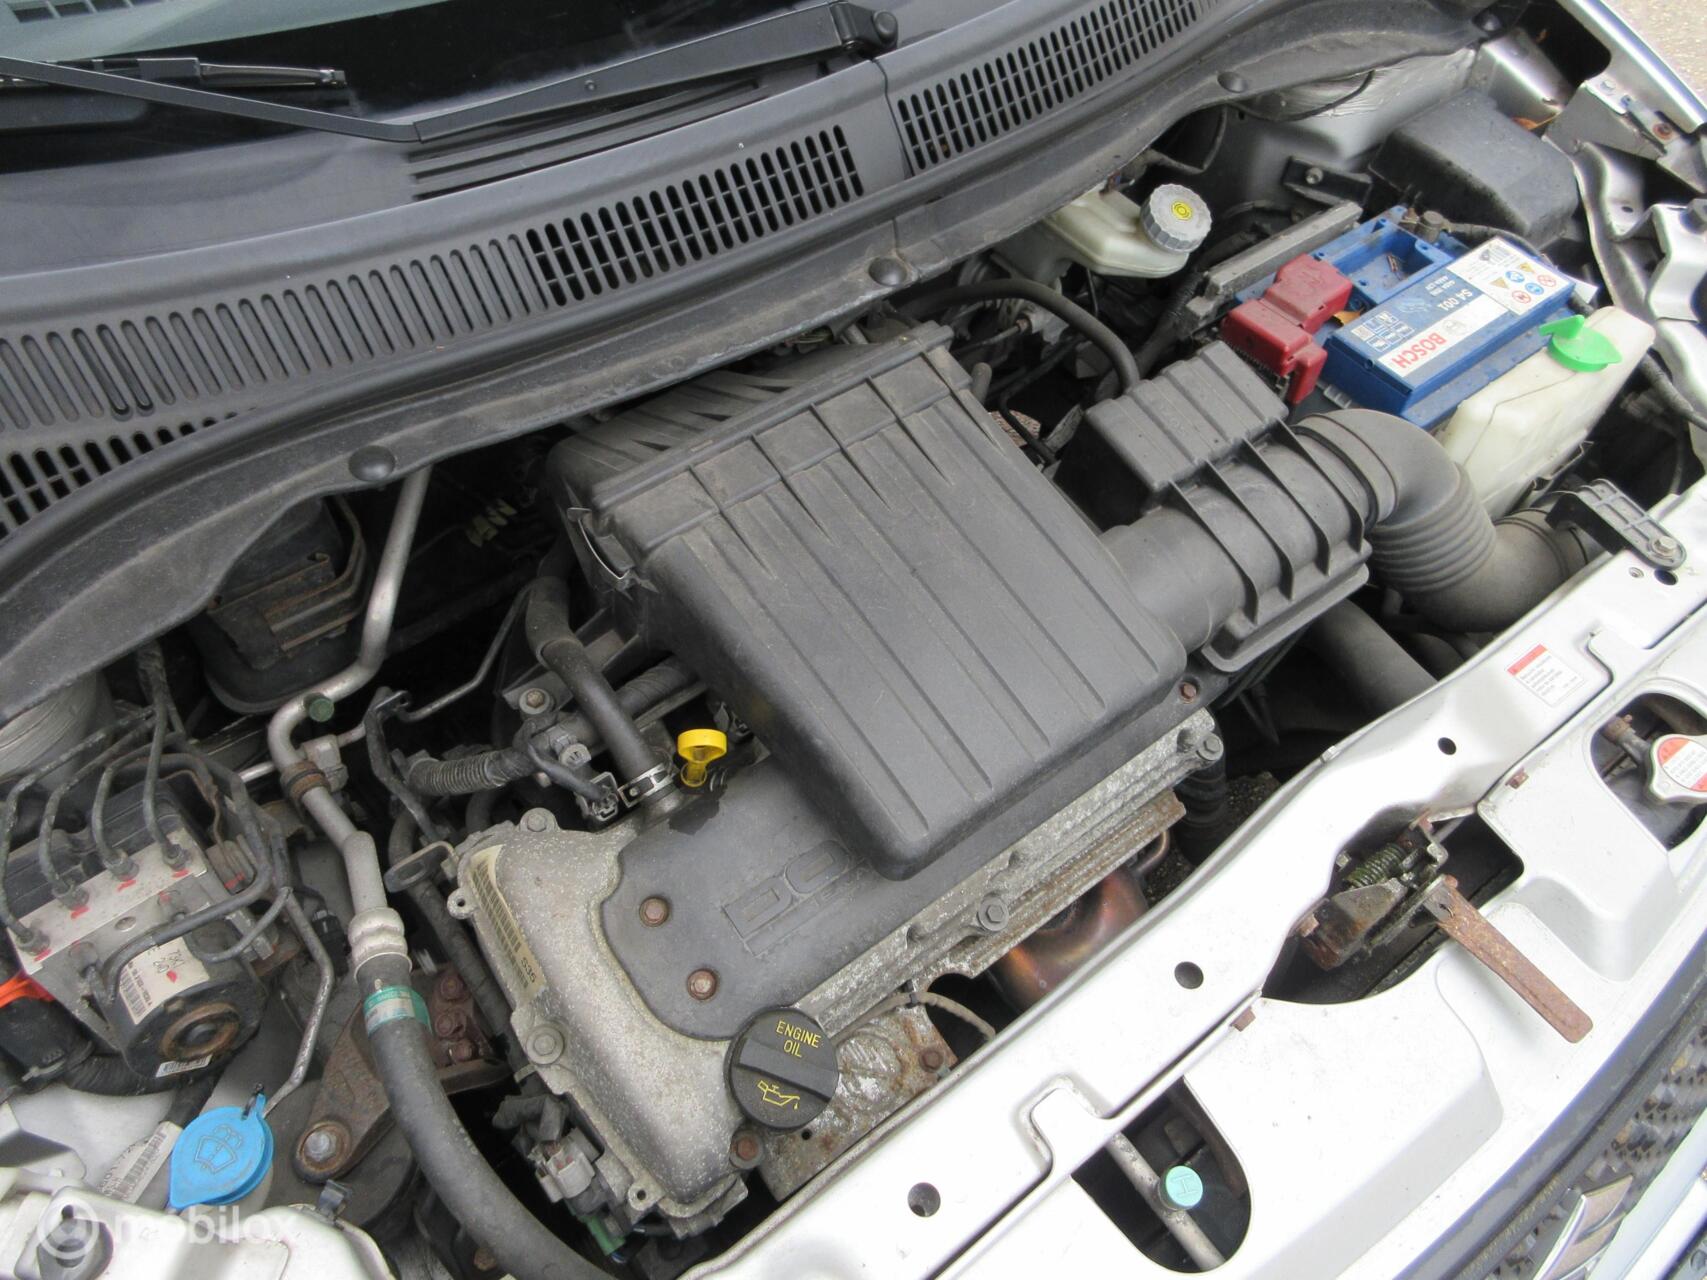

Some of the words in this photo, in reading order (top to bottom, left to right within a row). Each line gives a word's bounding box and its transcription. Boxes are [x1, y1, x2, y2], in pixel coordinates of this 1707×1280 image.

[1391, 332, 1447, 368] BOSCH
[776, 1021, 821, 1048] ENGINE
[783, 1040, 802, 1057] OIL
